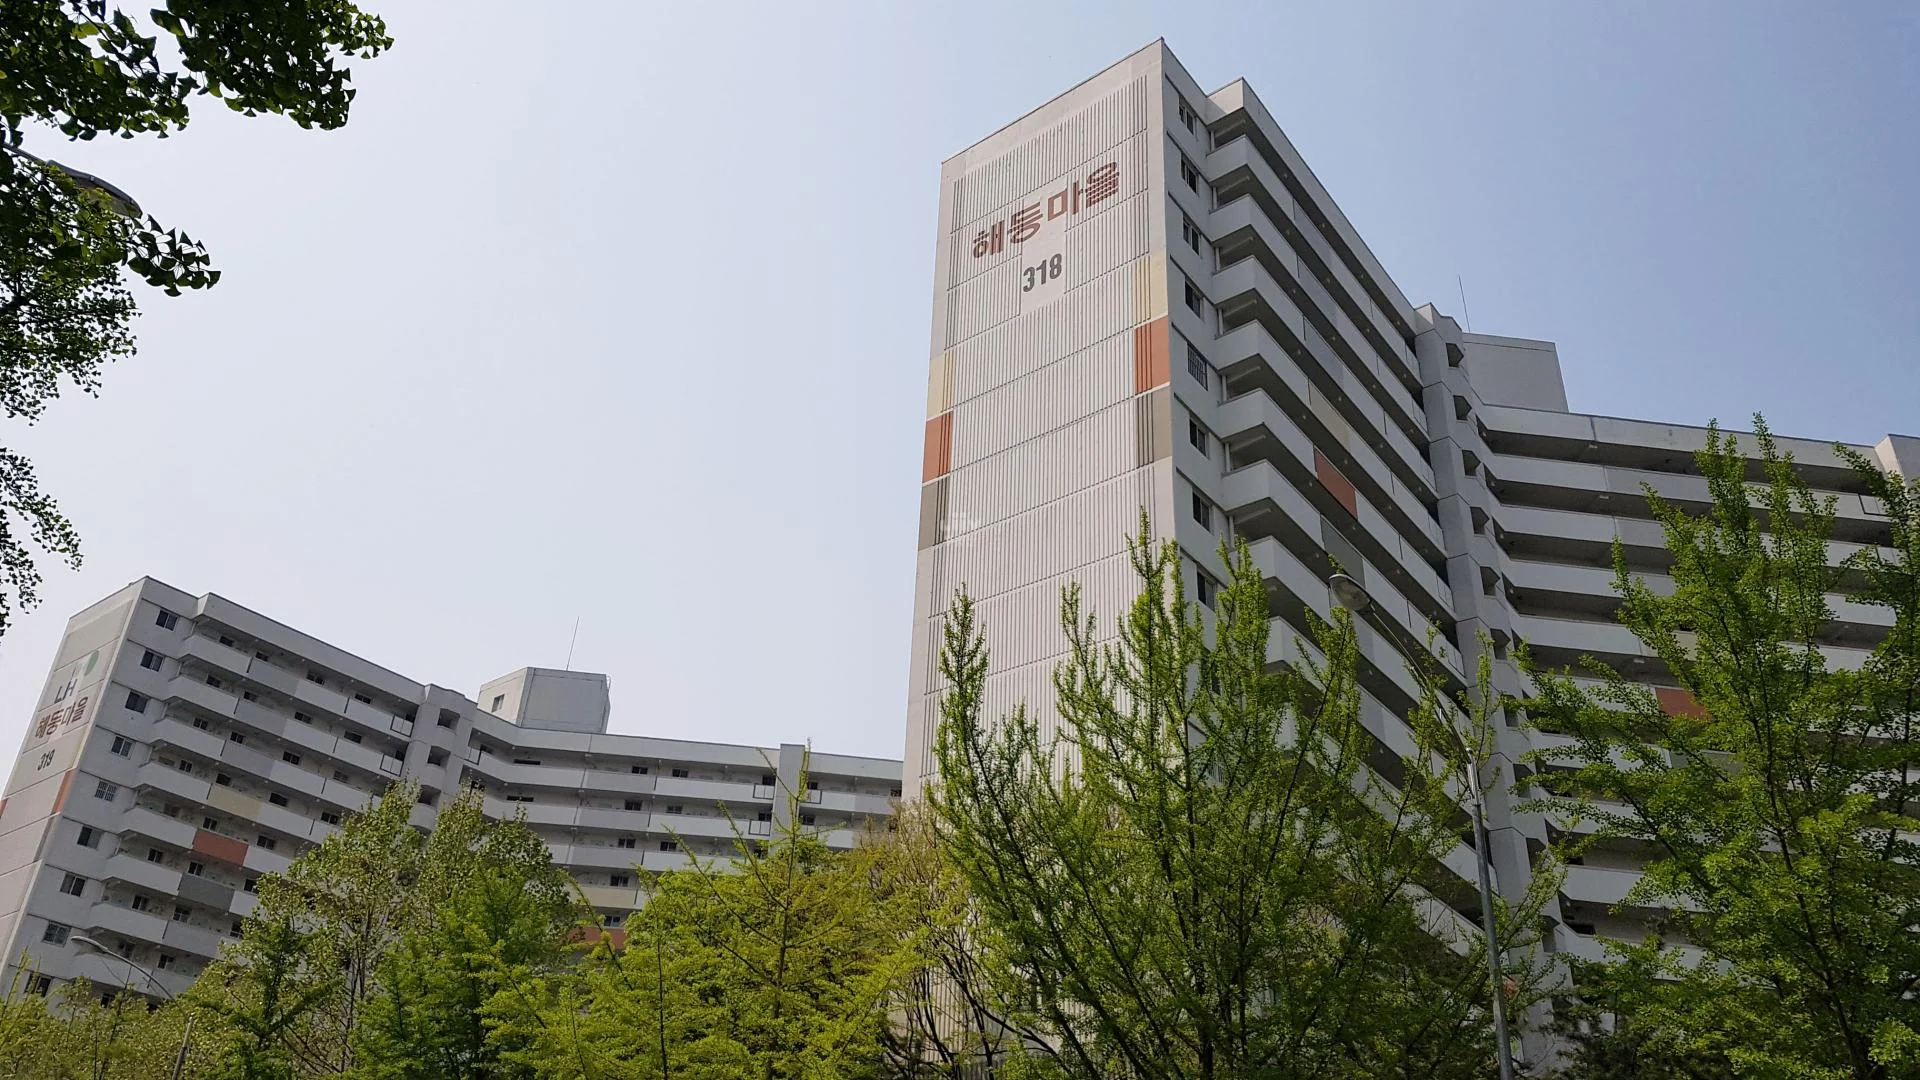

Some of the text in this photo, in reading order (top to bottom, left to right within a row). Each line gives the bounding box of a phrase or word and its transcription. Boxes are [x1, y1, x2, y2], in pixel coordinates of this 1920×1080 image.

[1022, 253, 1062, 292] 318
[54, 680, 77, 704] LH
[37, 748, 55, 771] 319
